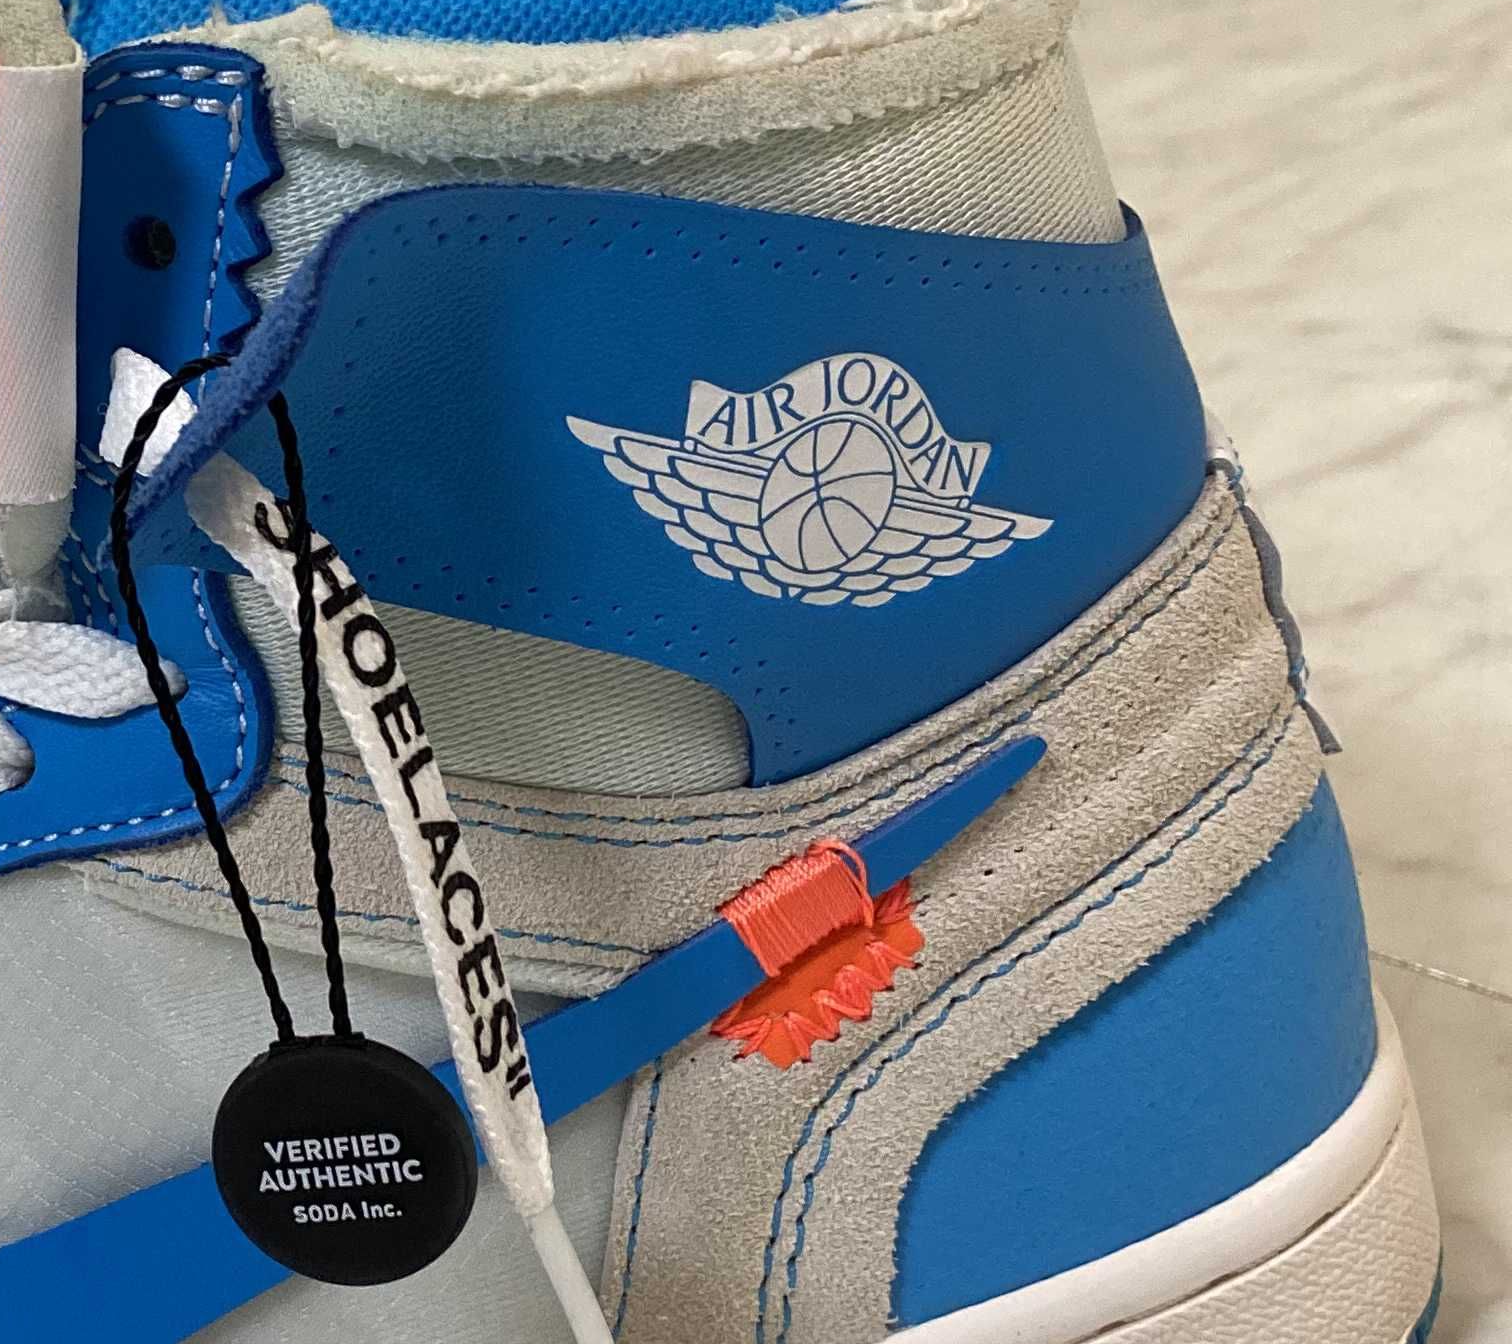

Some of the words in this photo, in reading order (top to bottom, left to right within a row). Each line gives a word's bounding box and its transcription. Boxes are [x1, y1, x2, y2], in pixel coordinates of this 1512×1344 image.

[698, 381, 806, 446] AIR
[820, 357, 979, 492] JORDAN
[263, 1132, 402, 1164] VERIFIED
[258, 1158, 424, 1193] AUTHENTIC
[292, 1201, 357, 1224] SODA
[361, 1200, 403, 1219] Inc.
